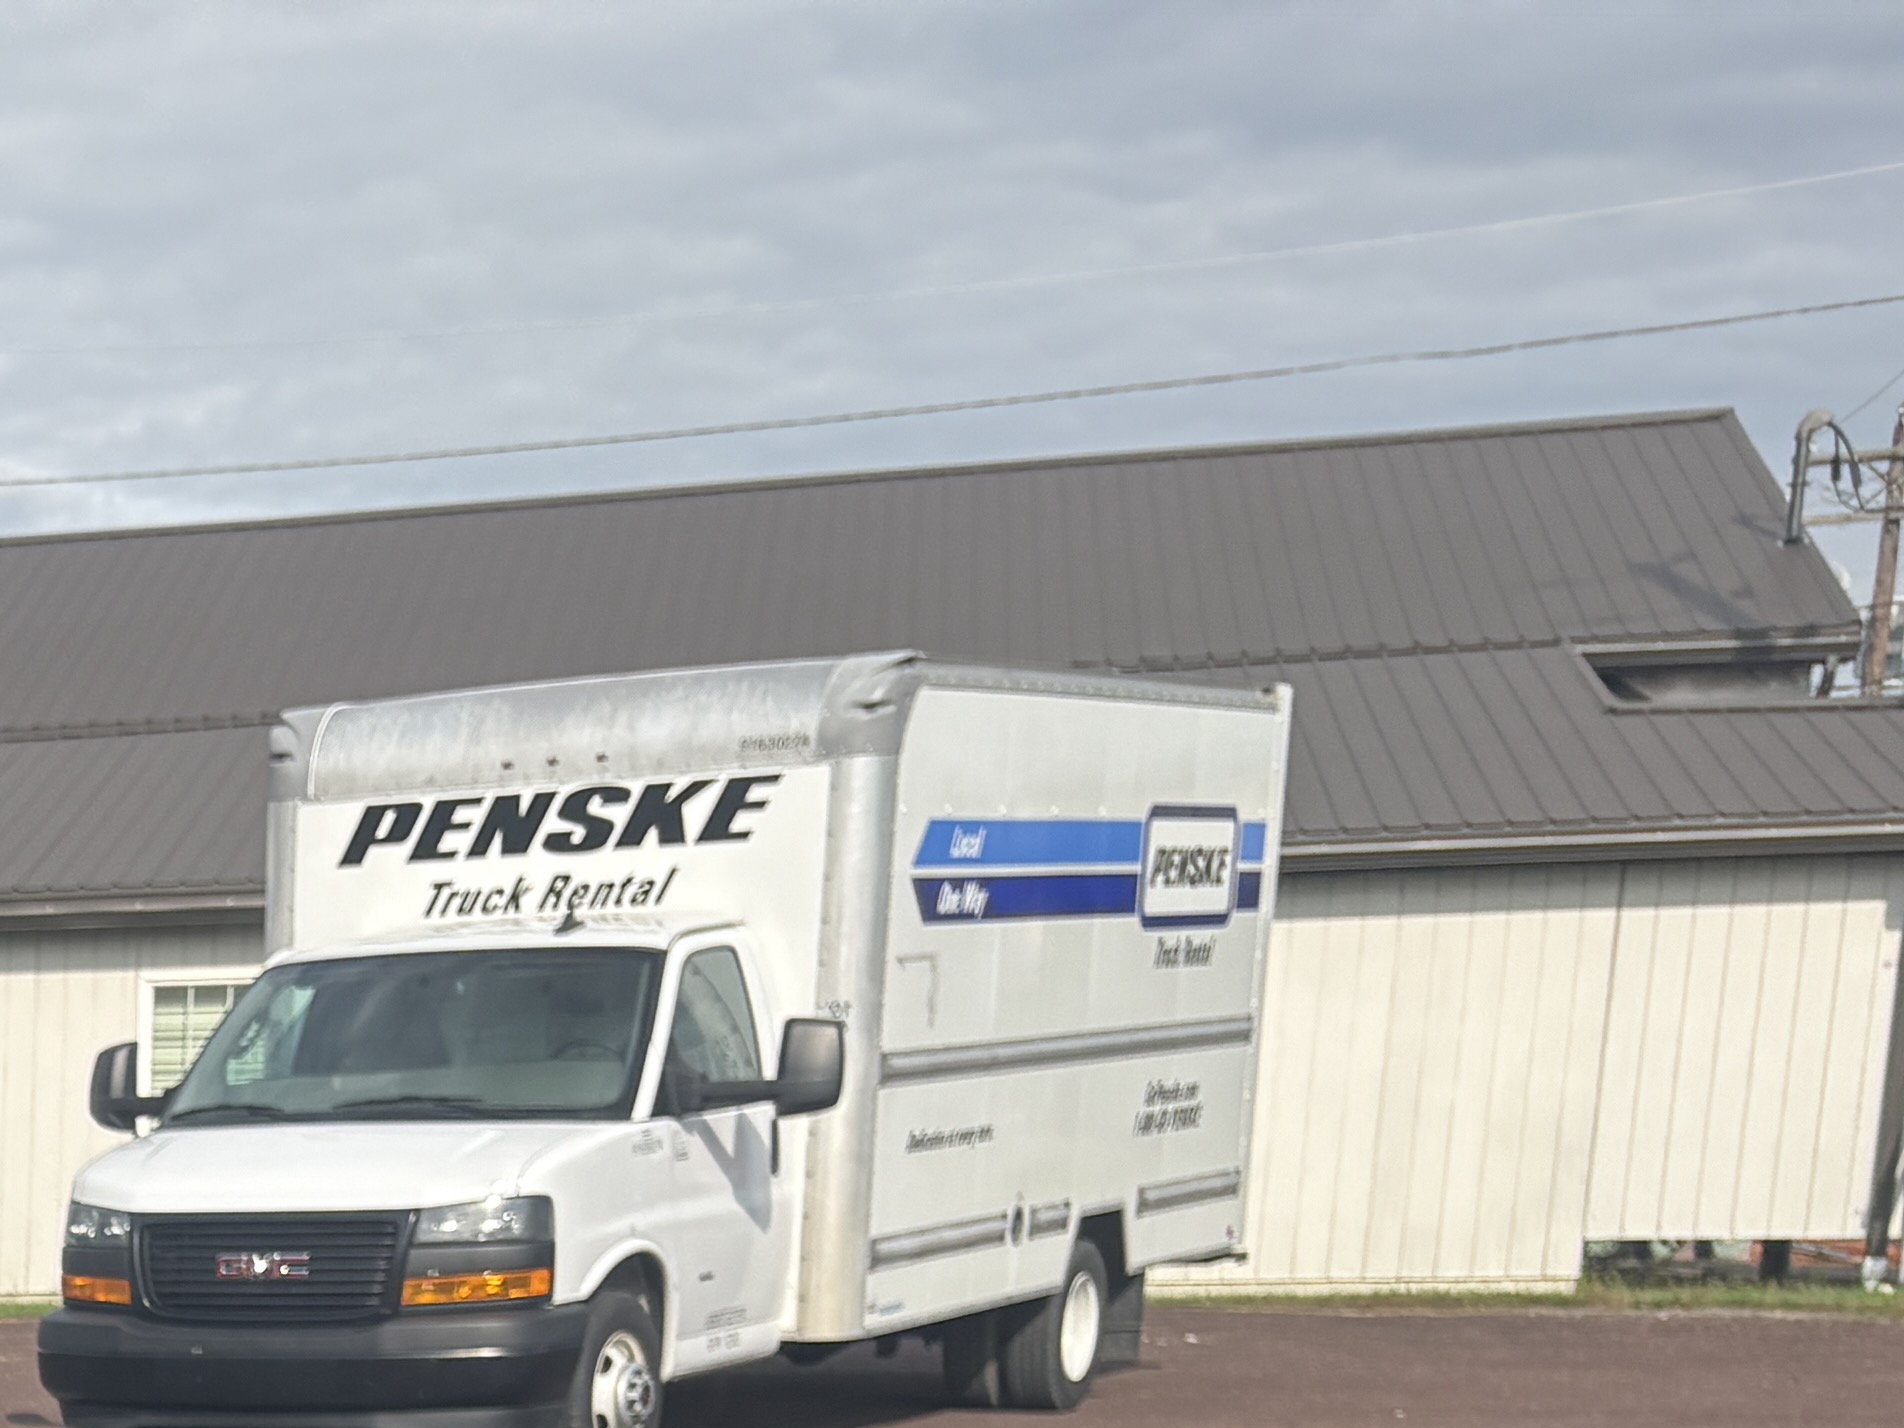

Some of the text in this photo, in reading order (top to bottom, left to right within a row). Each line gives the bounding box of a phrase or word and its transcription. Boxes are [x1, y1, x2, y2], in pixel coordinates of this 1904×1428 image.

[337, 774, 784, 868] PENSKE
[423, 866, 678, 918] Truck Rental
[1150, 844, 1230, 889] PENSKE
